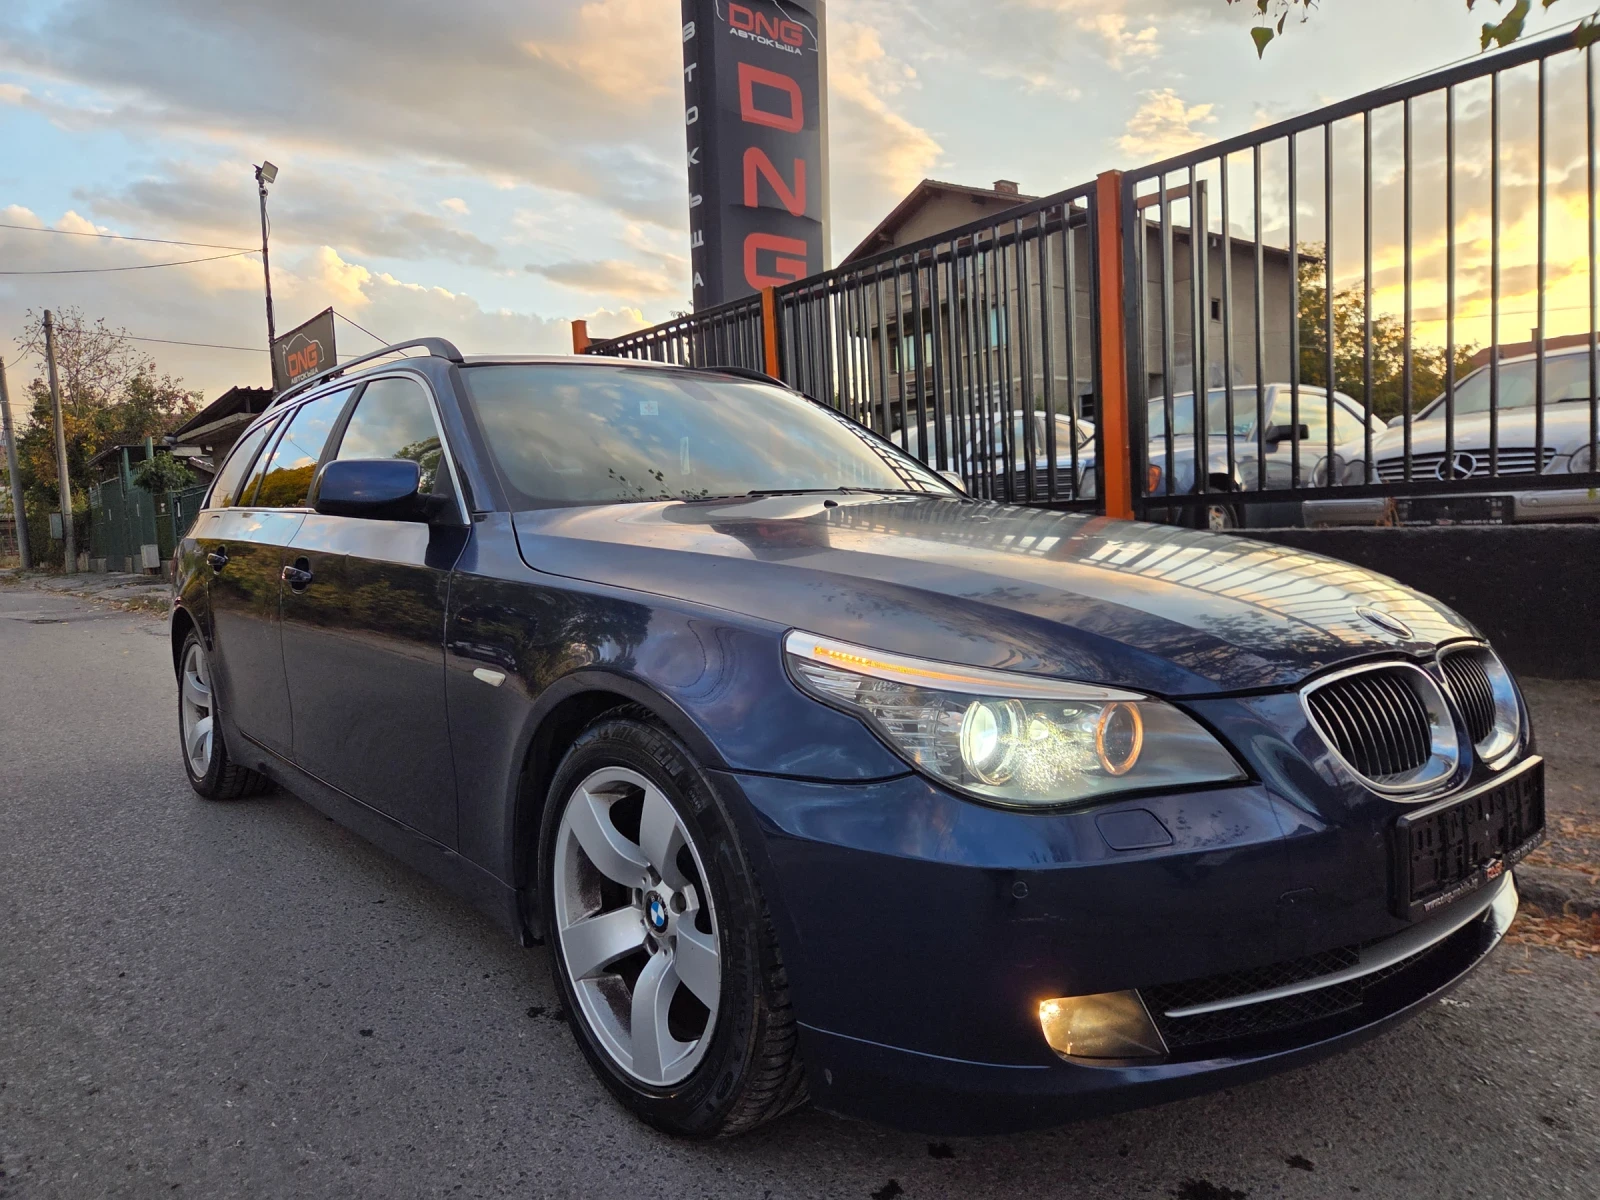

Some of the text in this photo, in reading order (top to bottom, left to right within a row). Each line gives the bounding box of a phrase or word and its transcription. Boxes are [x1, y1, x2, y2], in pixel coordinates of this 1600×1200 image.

[729, 2, 803, 47] DNG
[729, 27, 803, 56] АВТОКЪЩА
[738, 62, 807, 292] DNG
[287, 342, 318, 377] DNG
